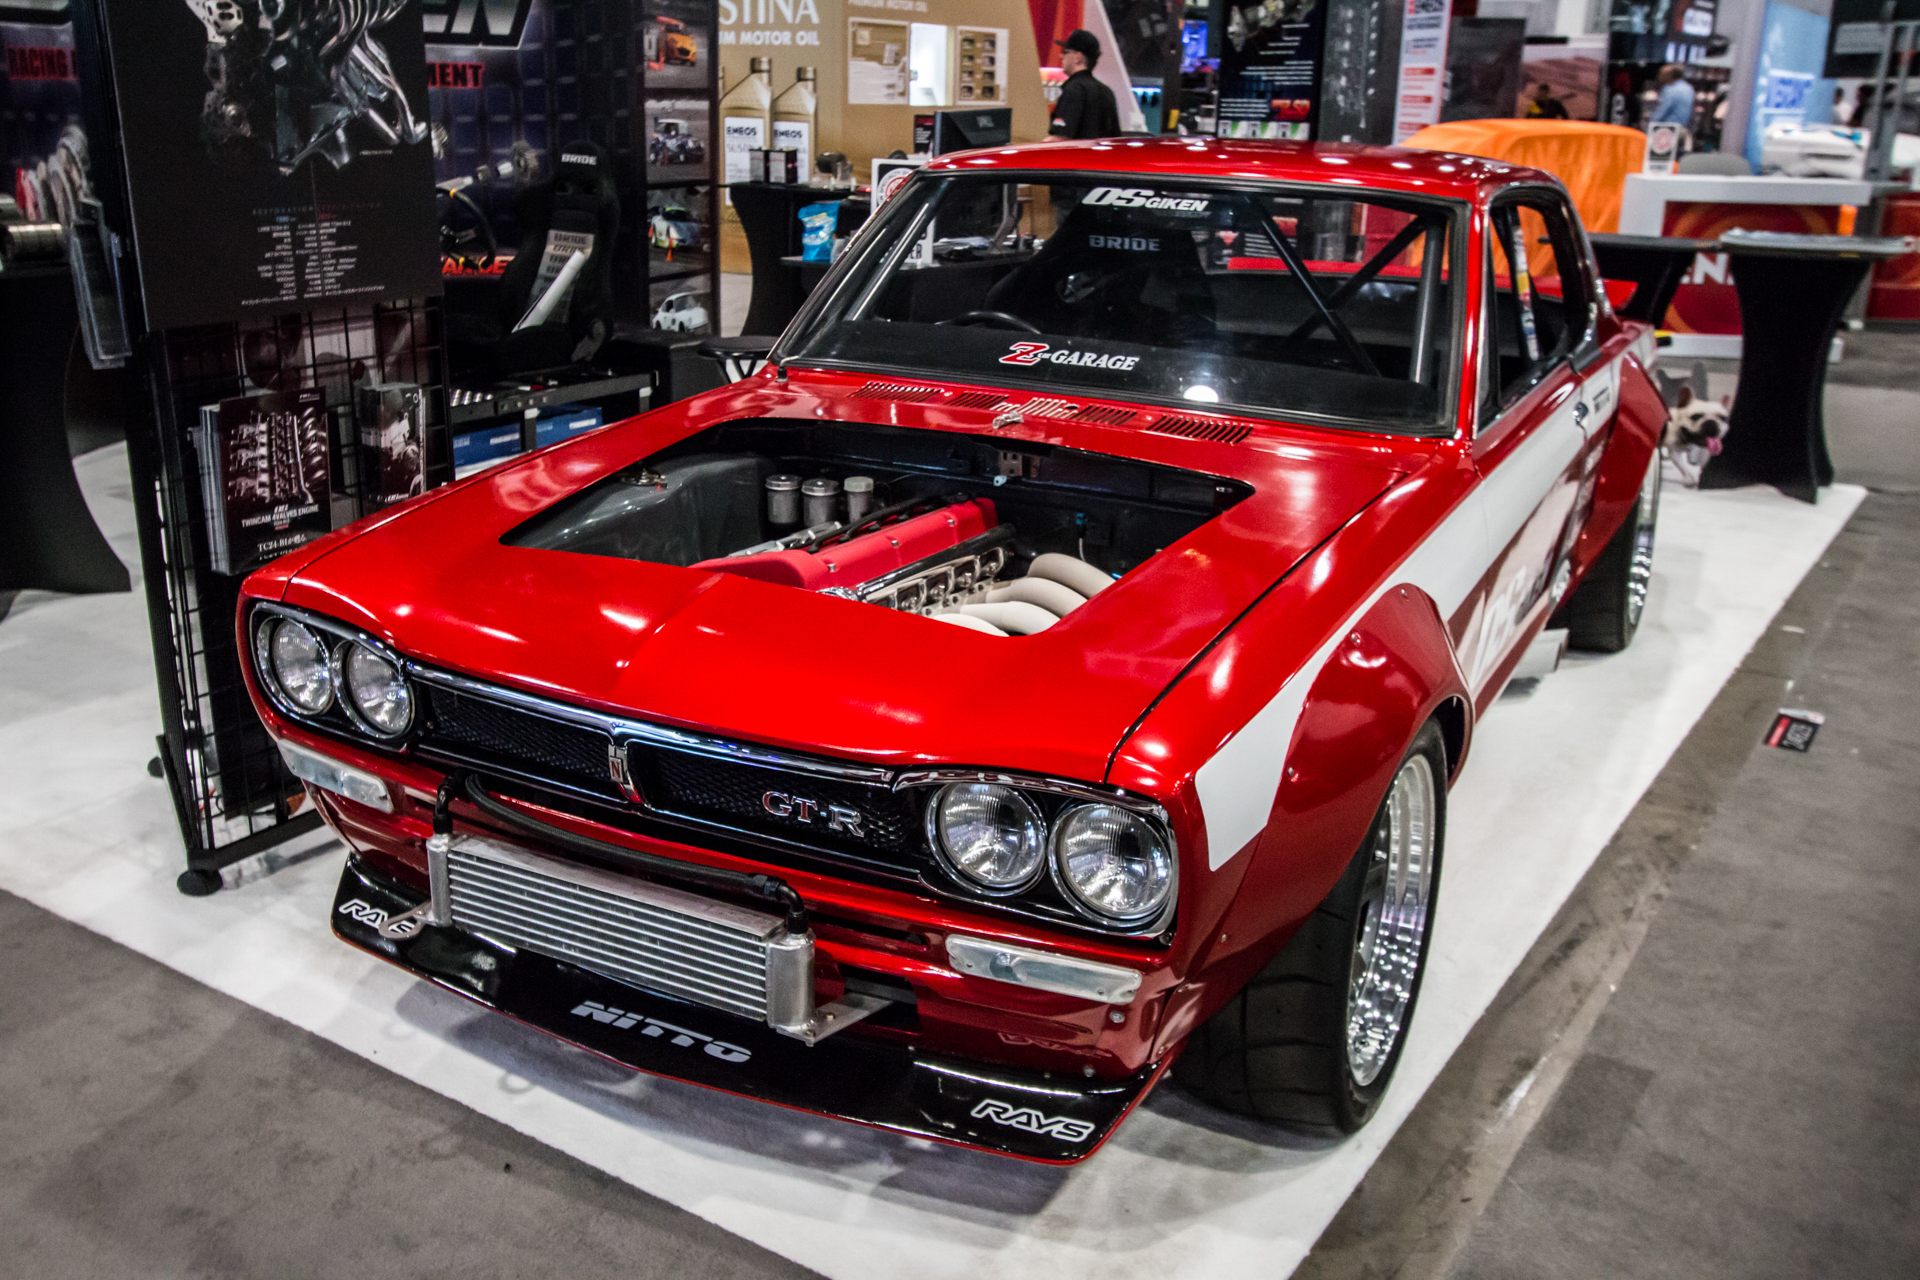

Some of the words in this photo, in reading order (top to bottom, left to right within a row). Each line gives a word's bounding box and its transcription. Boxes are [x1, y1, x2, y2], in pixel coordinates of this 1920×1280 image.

[739, 30, 792, 46] MOTOR
[795, 30, 820, 46] OIL
[561, 153, 597, 165] BRIDE
[1081, 186, 1155, 208] OS
[1144, 197, 1209, 212] GIKEN
[1089, 234, 1160, 252] BRIDE
[1050, 349, 1140, 371] GARAGE
[241, 514, 271, 528] TWINCAM
[297, 504, 319, 516] ENGINE
[762, 790, 865, 838] GT-R
[570, 1000, 752, 1064] NITTO
[970, 1099, 1096, 1143] RAYS
